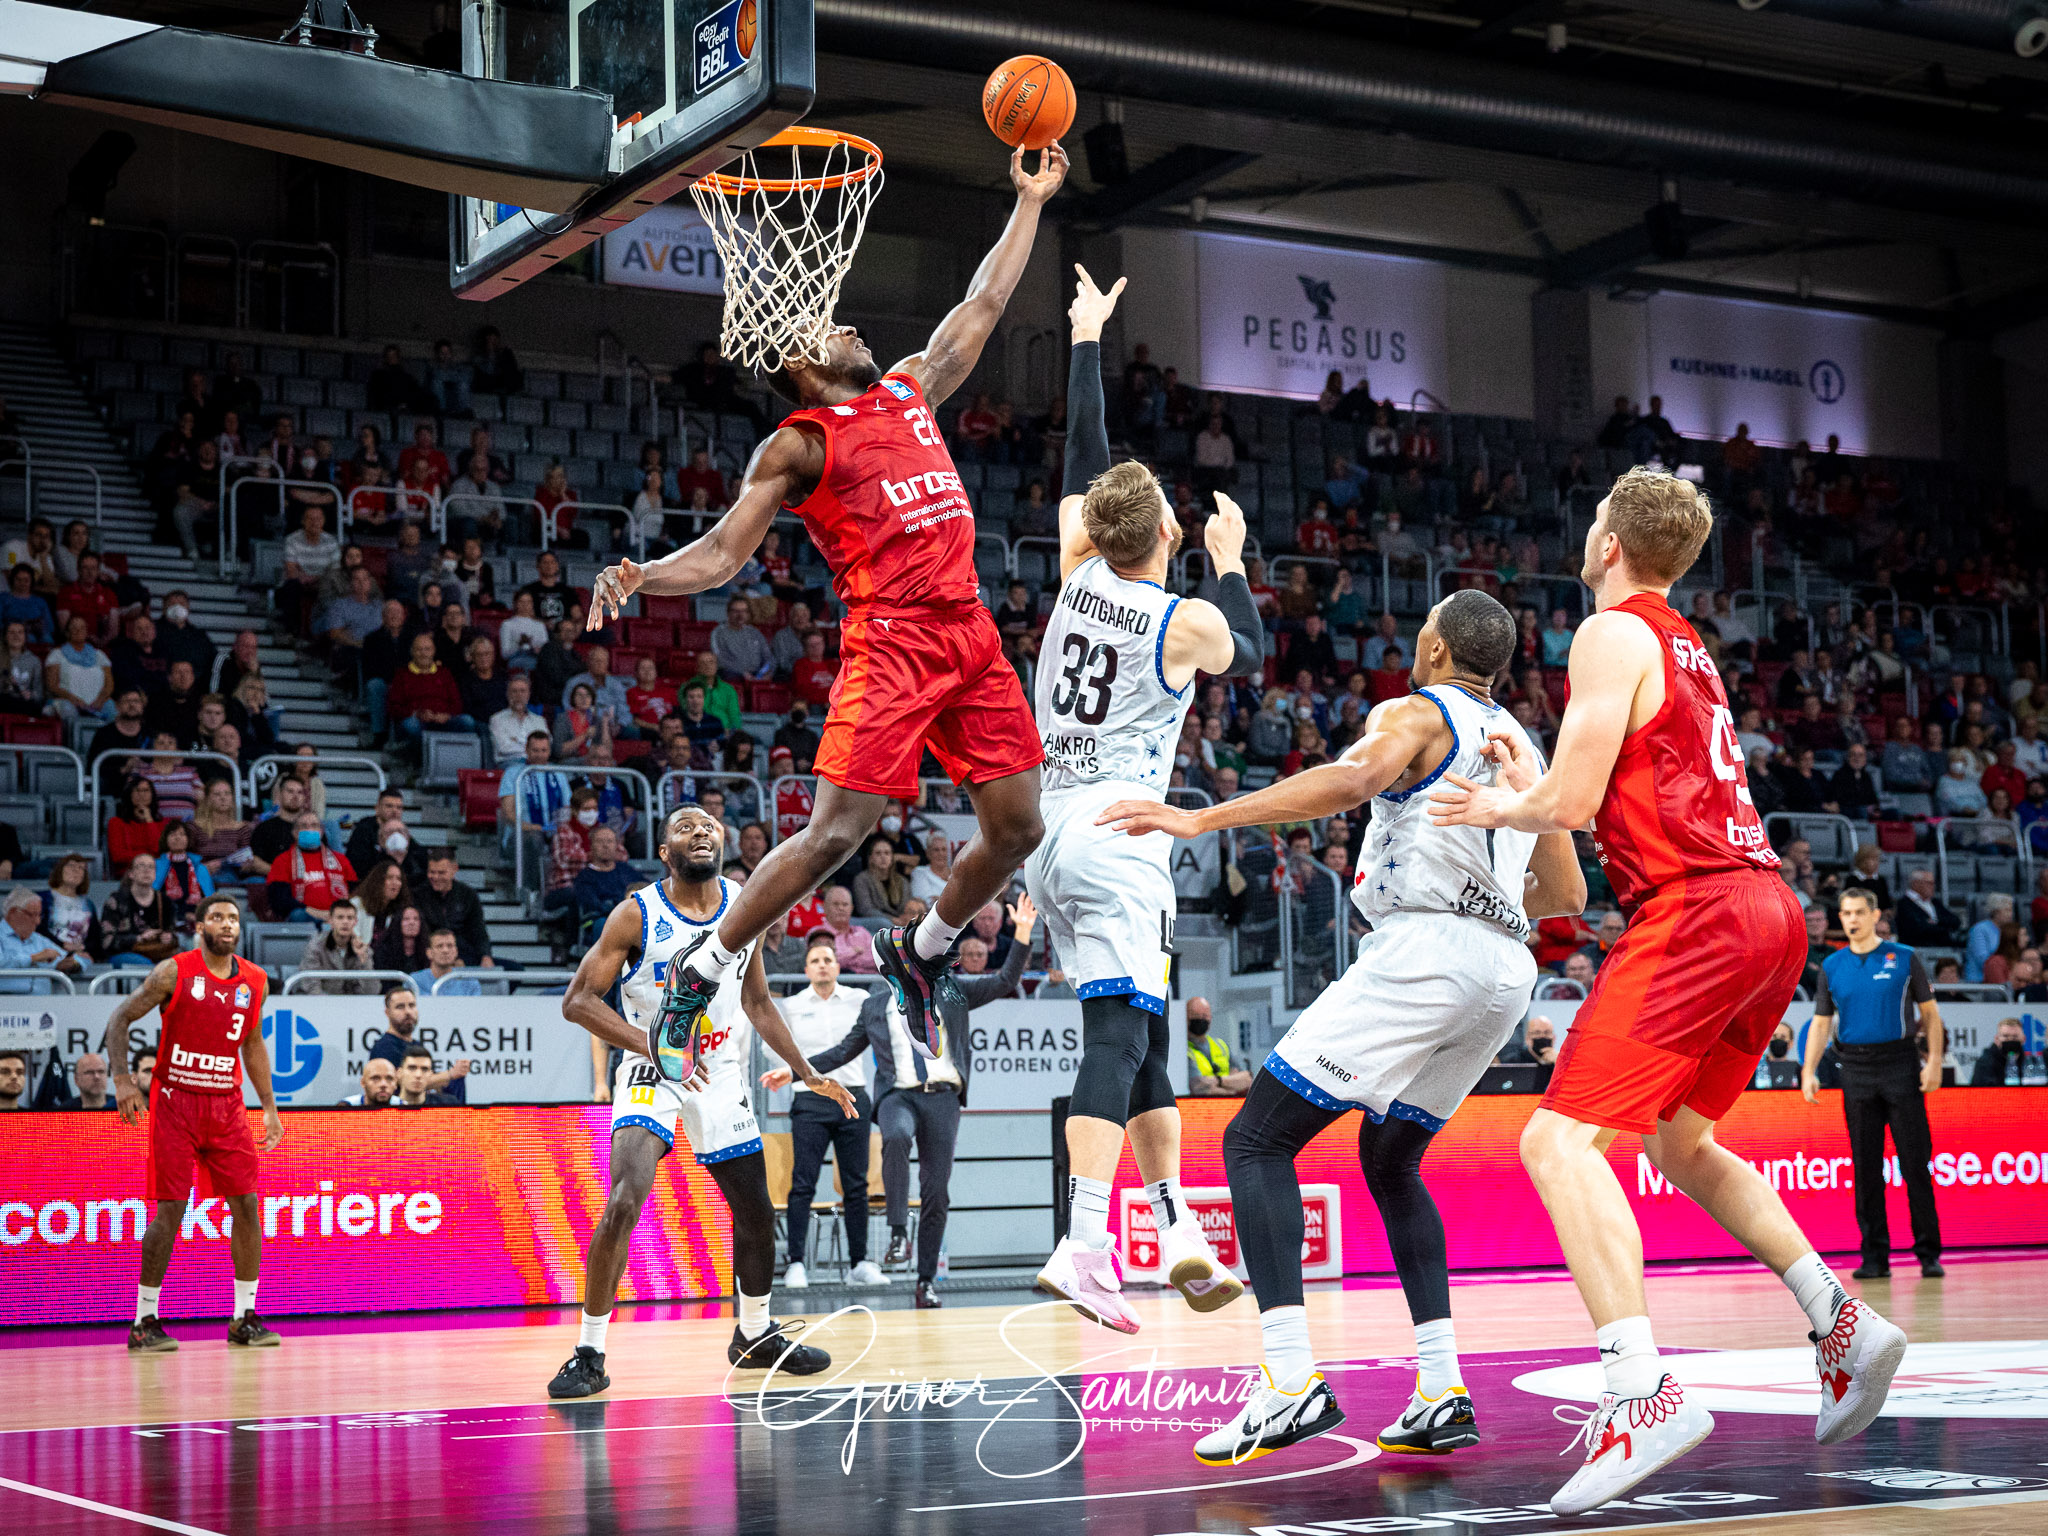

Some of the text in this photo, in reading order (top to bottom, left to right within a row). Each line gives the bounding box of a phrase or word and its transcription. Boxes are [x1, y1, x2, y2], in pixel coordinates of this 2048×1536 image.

[700, 43, 730, 84] BBL
[1000, 78, 1039, 136] SPALDING
[1243, 315, 1406, 364] PEGASUS
[904, 521, 920, 534] der
[1061, 582, 1152, 636] MIDTGAARD
[1051, 632, 1119, 726] 33
[1042, 732, 1097, 756] HAKRO
[226, 1013, 245, 1041] 3
[346, 1027, 533, 1052] IGRASHI
[970, 1028, 1078, 1052] GARAS
[469, 1059, 533, 1075] GMBH
[974, 1058, 1052, 1073] OTOREN
[1315, 1054, 1352, 1083] HAKRO
